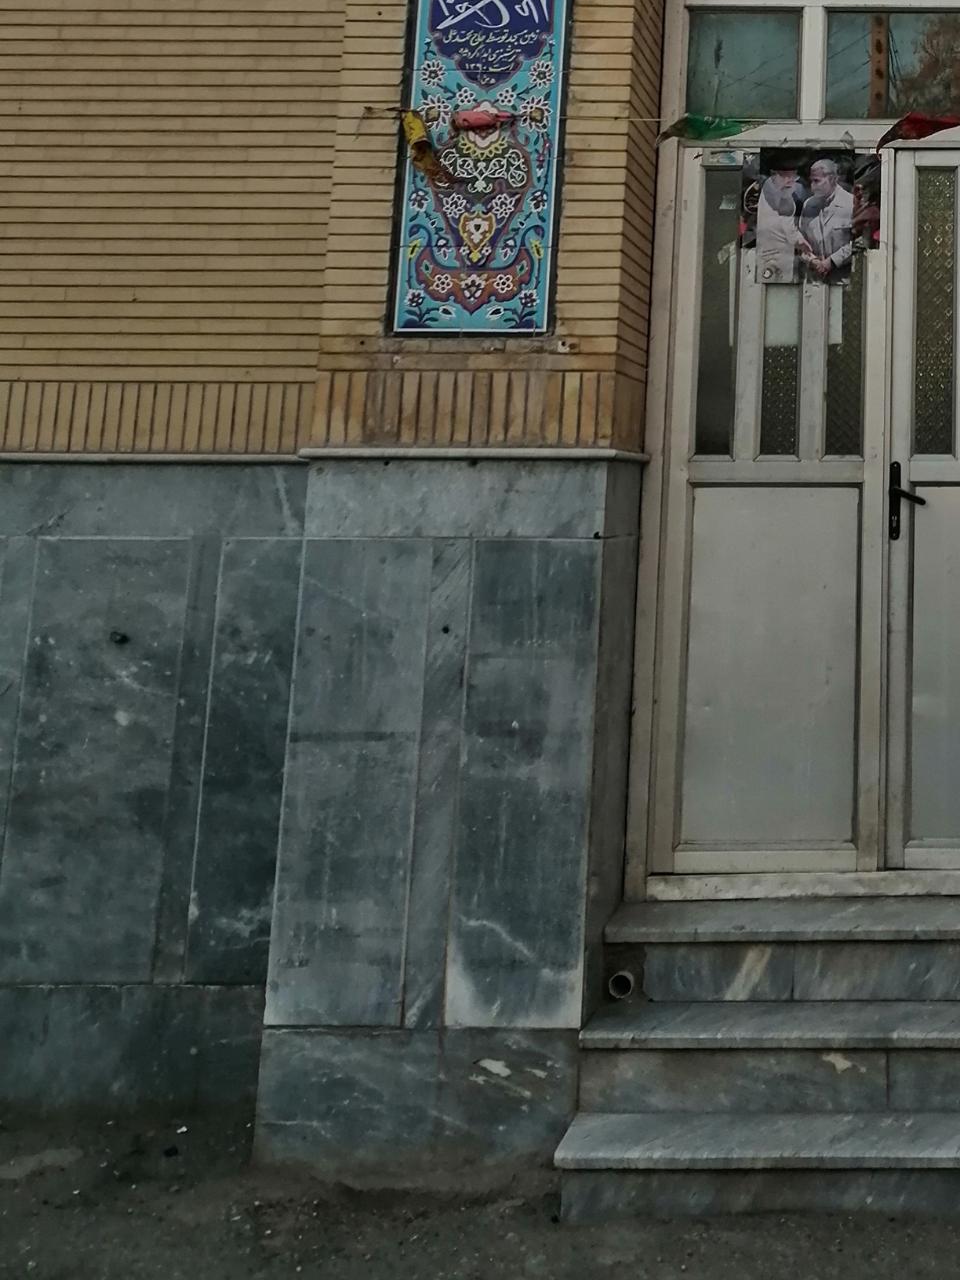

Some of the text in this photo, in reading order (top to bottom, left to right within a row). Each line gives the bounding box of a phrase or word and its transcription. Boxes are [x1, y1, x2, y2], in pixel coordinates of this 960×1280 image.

[470, 31, 487, 46] حاج
[485, 29, 509, 43] توسط
[505, 29, 529, 45] مسجد
[519, 29, 540, 45] زمین
[488, 62, 515, 72] است
